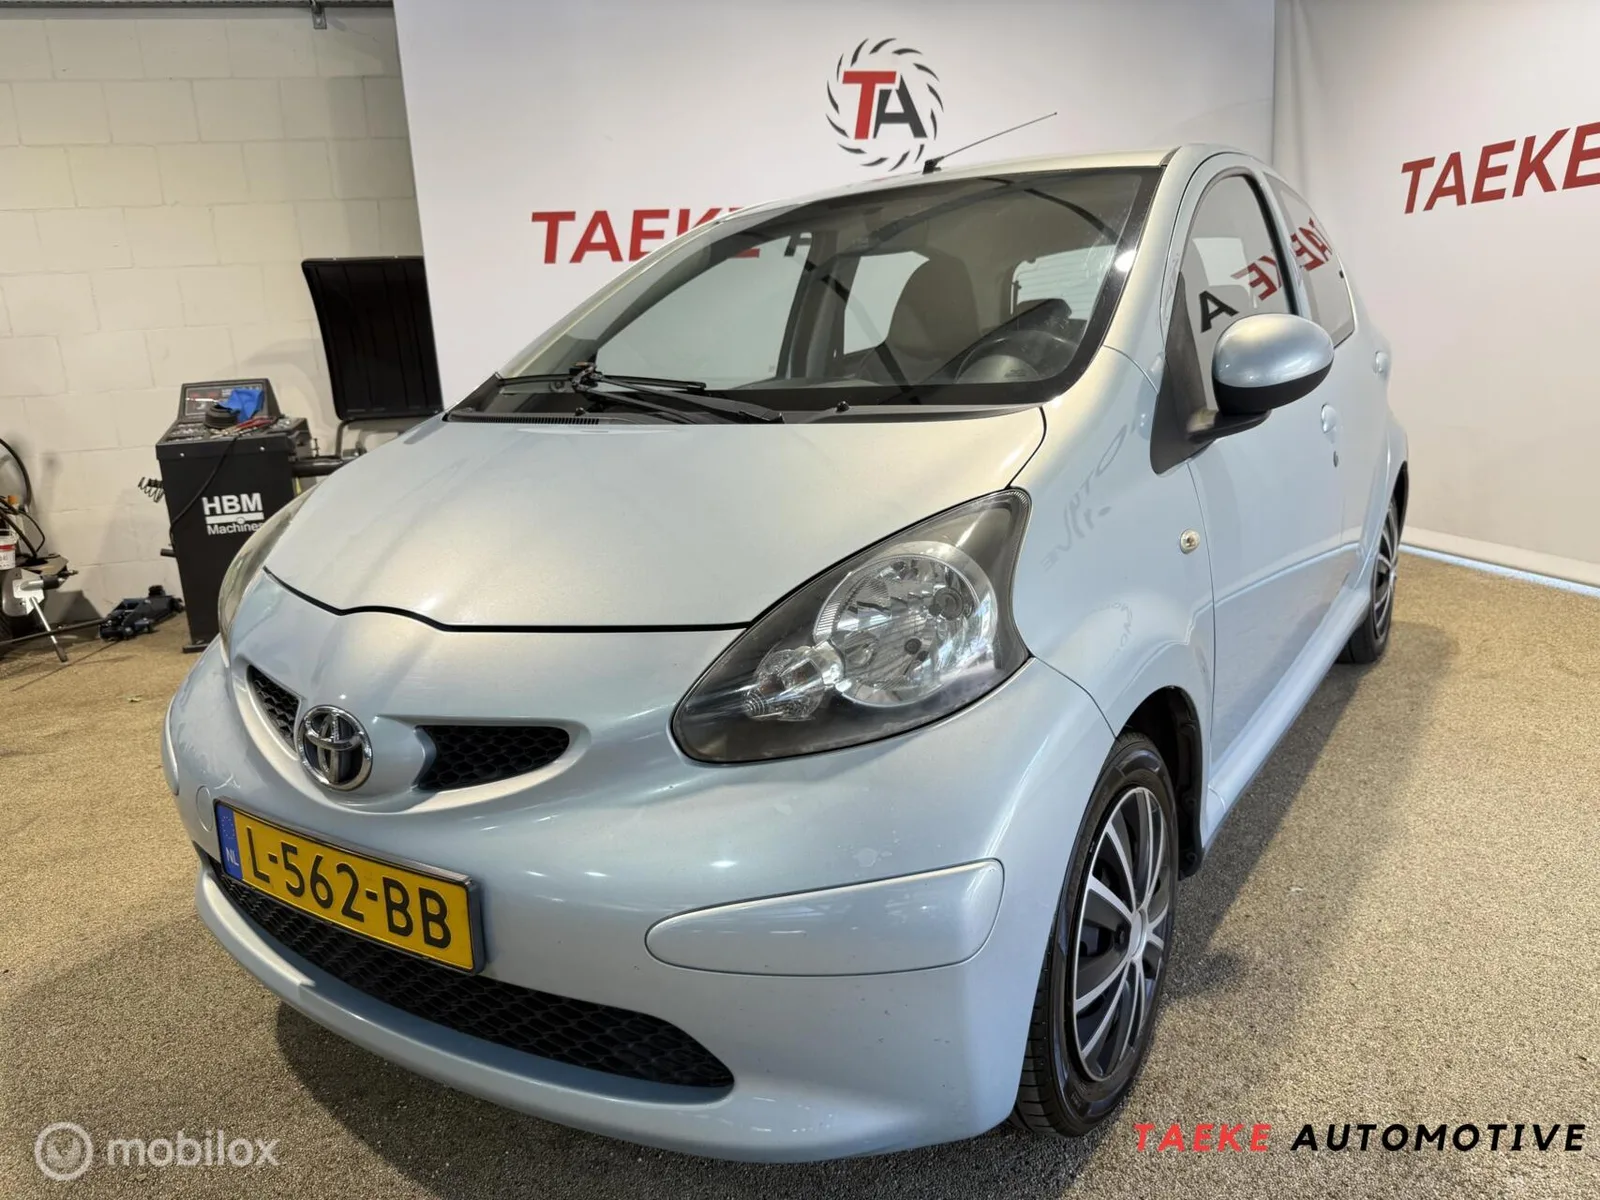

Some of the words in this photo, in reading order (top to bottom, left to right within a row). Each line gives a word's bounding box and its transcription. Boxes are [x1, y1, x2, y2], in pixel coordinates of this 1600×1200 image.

[842, 71, 927, 139] TA
[1401, 121, 1600, 214] TAEKE
[531, 207, 760, 264] TAE
[202, 492, 263, 515] HBM
[226, 846, 240, 866] NL
[245, 826, 452, 949] L-562-BB
